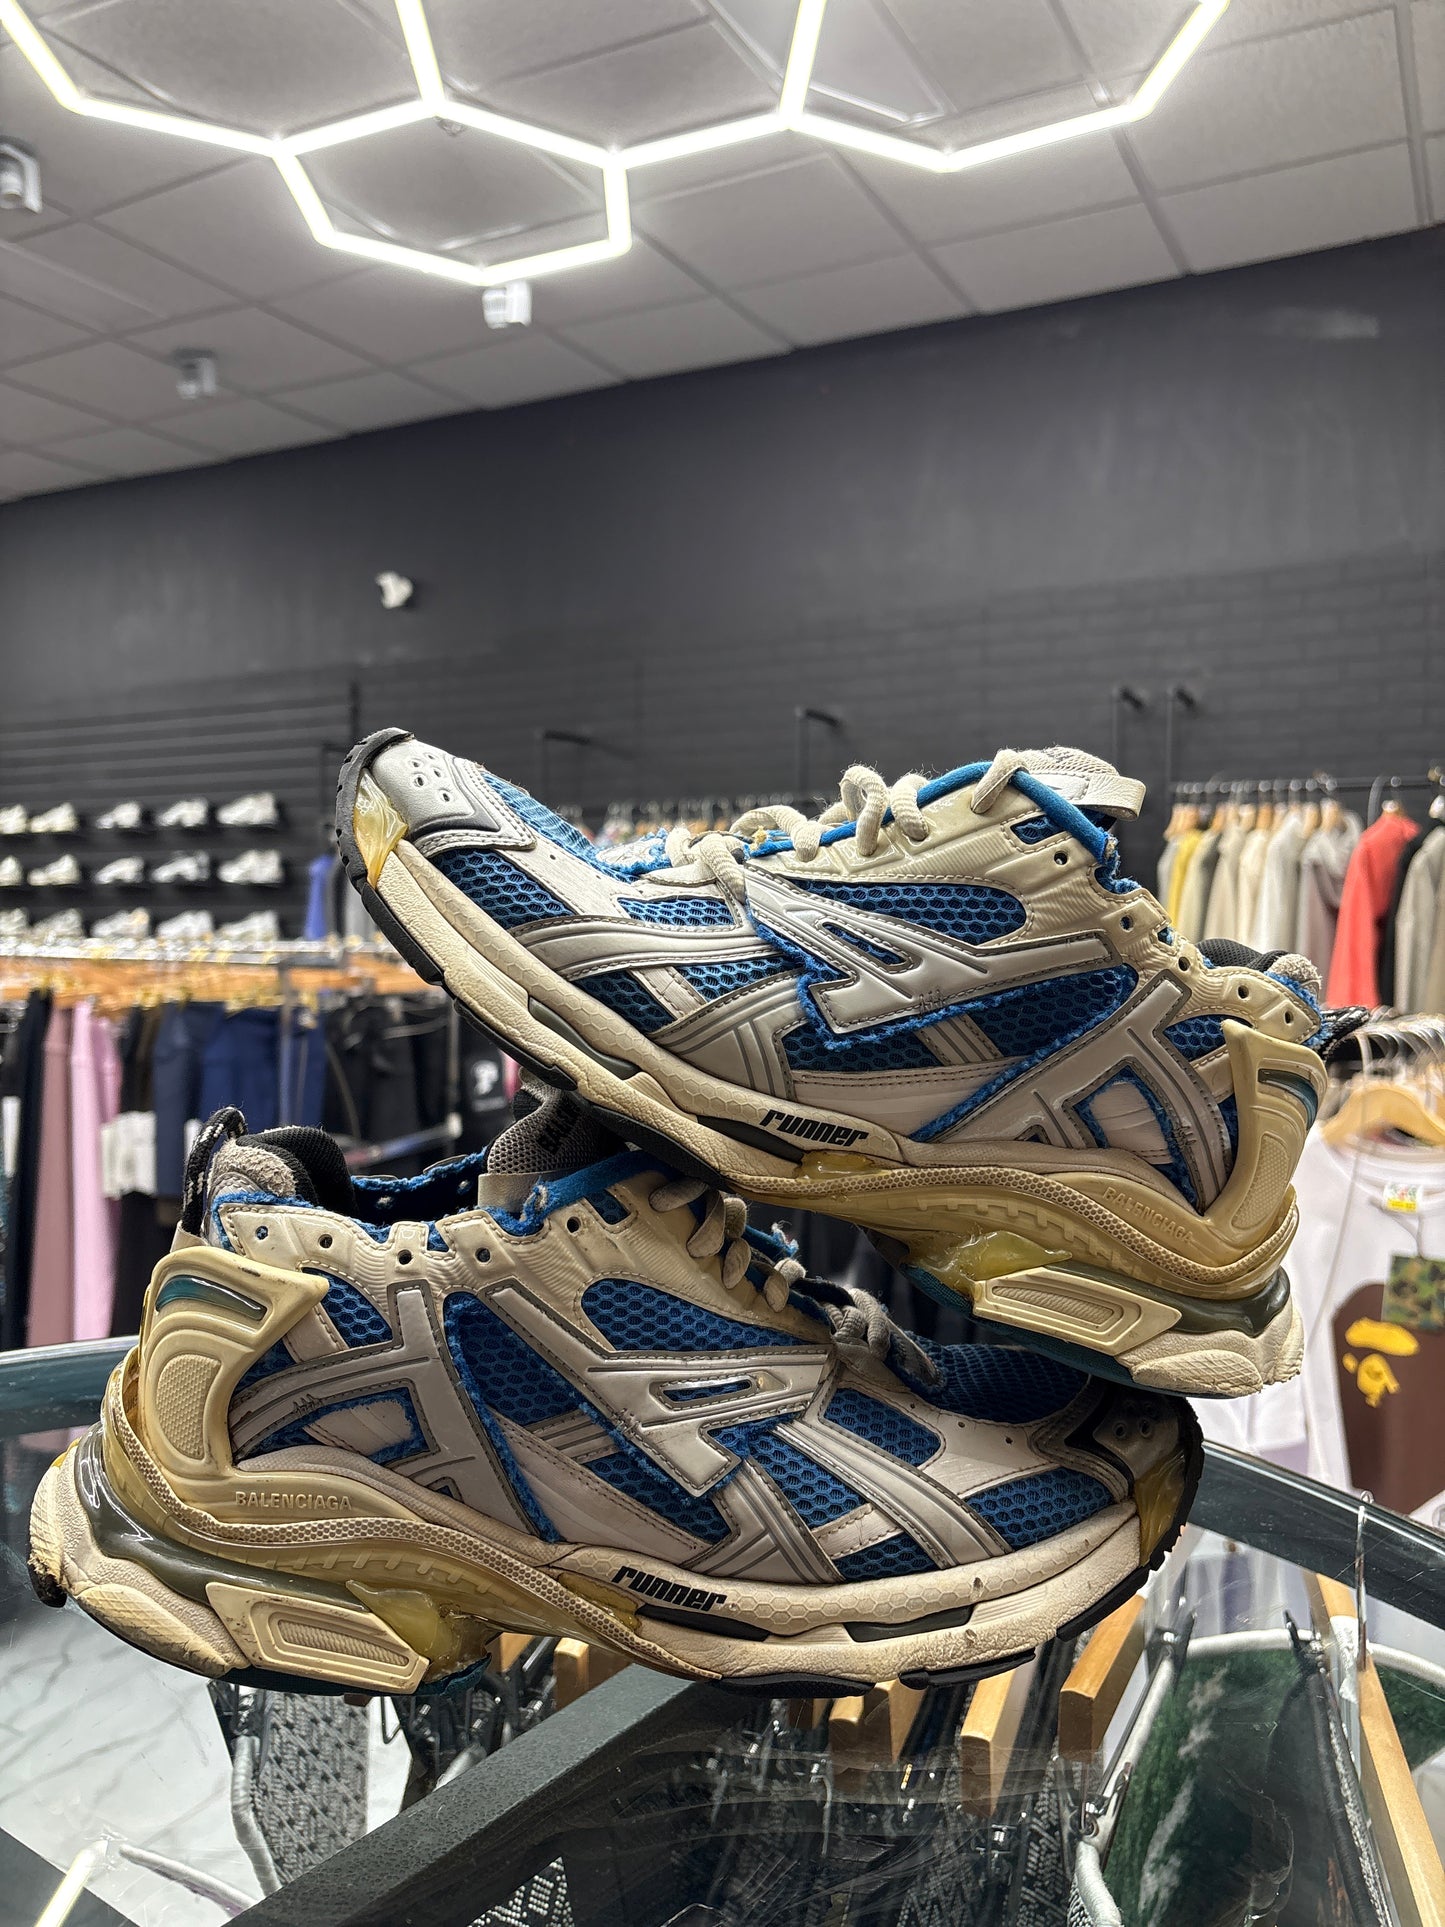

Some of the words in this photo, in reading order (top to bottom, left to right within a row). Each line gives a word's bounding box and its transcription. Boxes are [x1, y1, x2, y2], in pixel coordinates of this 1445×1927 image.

[759, 1109, 869, 1147] runner
[1103, 1186, 1194, 1242] BALENCIAGA
[235, 1491, 352, 1510] BALENCIAGA
[611, 1565, 728, 1611] runner
